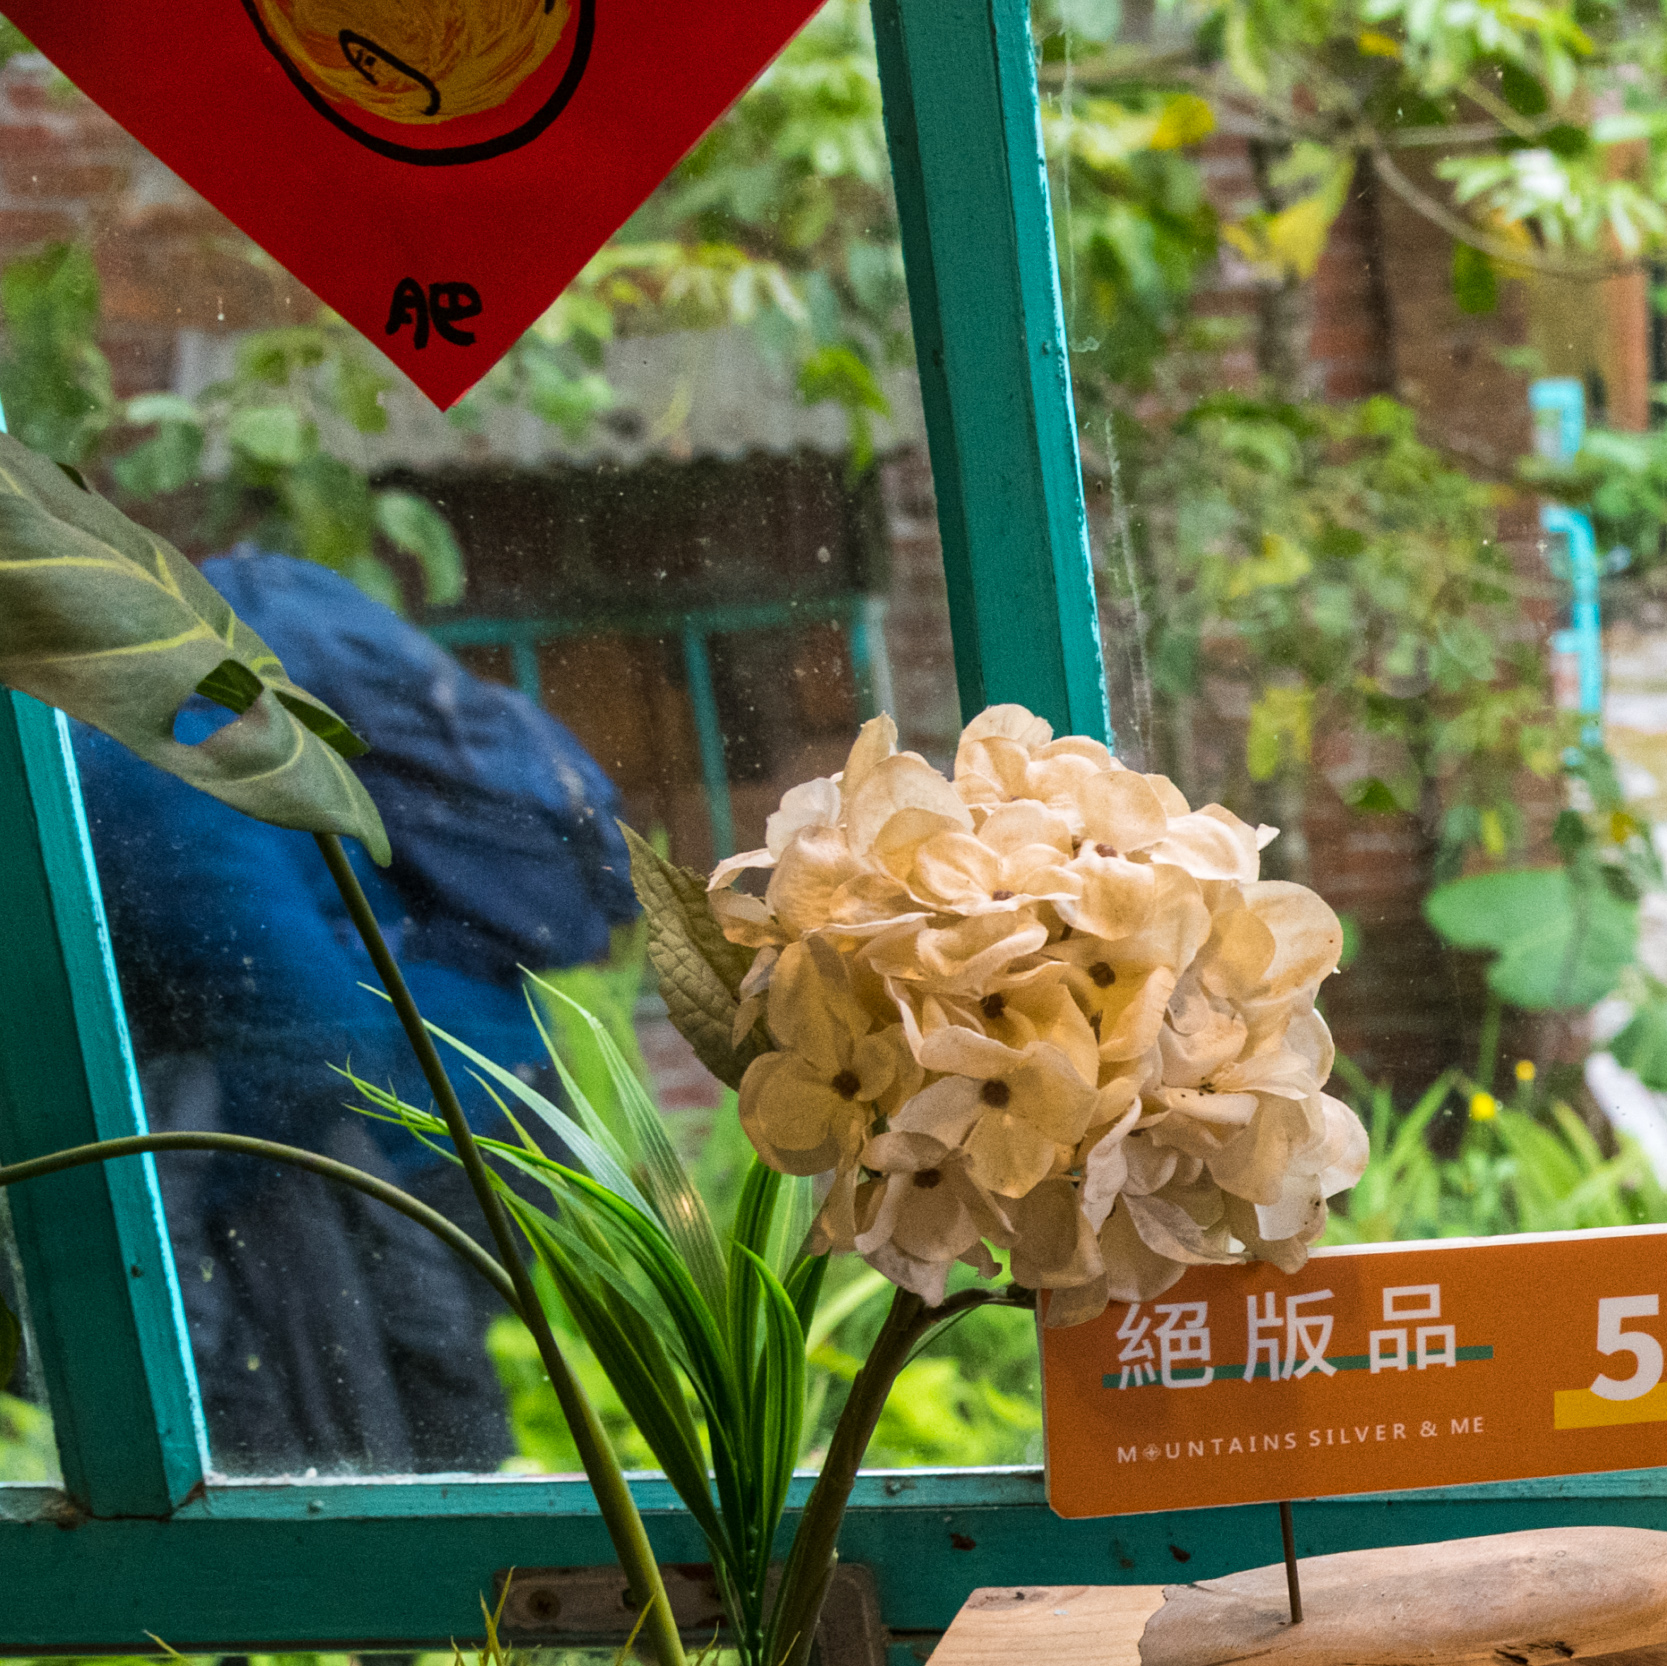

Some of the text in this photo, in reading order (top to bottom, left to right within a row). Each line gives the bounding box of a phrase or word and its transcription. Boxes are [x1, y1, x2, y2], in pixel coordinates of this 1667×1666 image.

[386, 277, 482, 350] 肥
[1117, 1284, 1456, 1390] 絕版品
[1309, 1422, 1407, 1447] SILVER
[1419, 1420, 1438, 1438] &
[1450, 1416, 1485, 1435] ME
